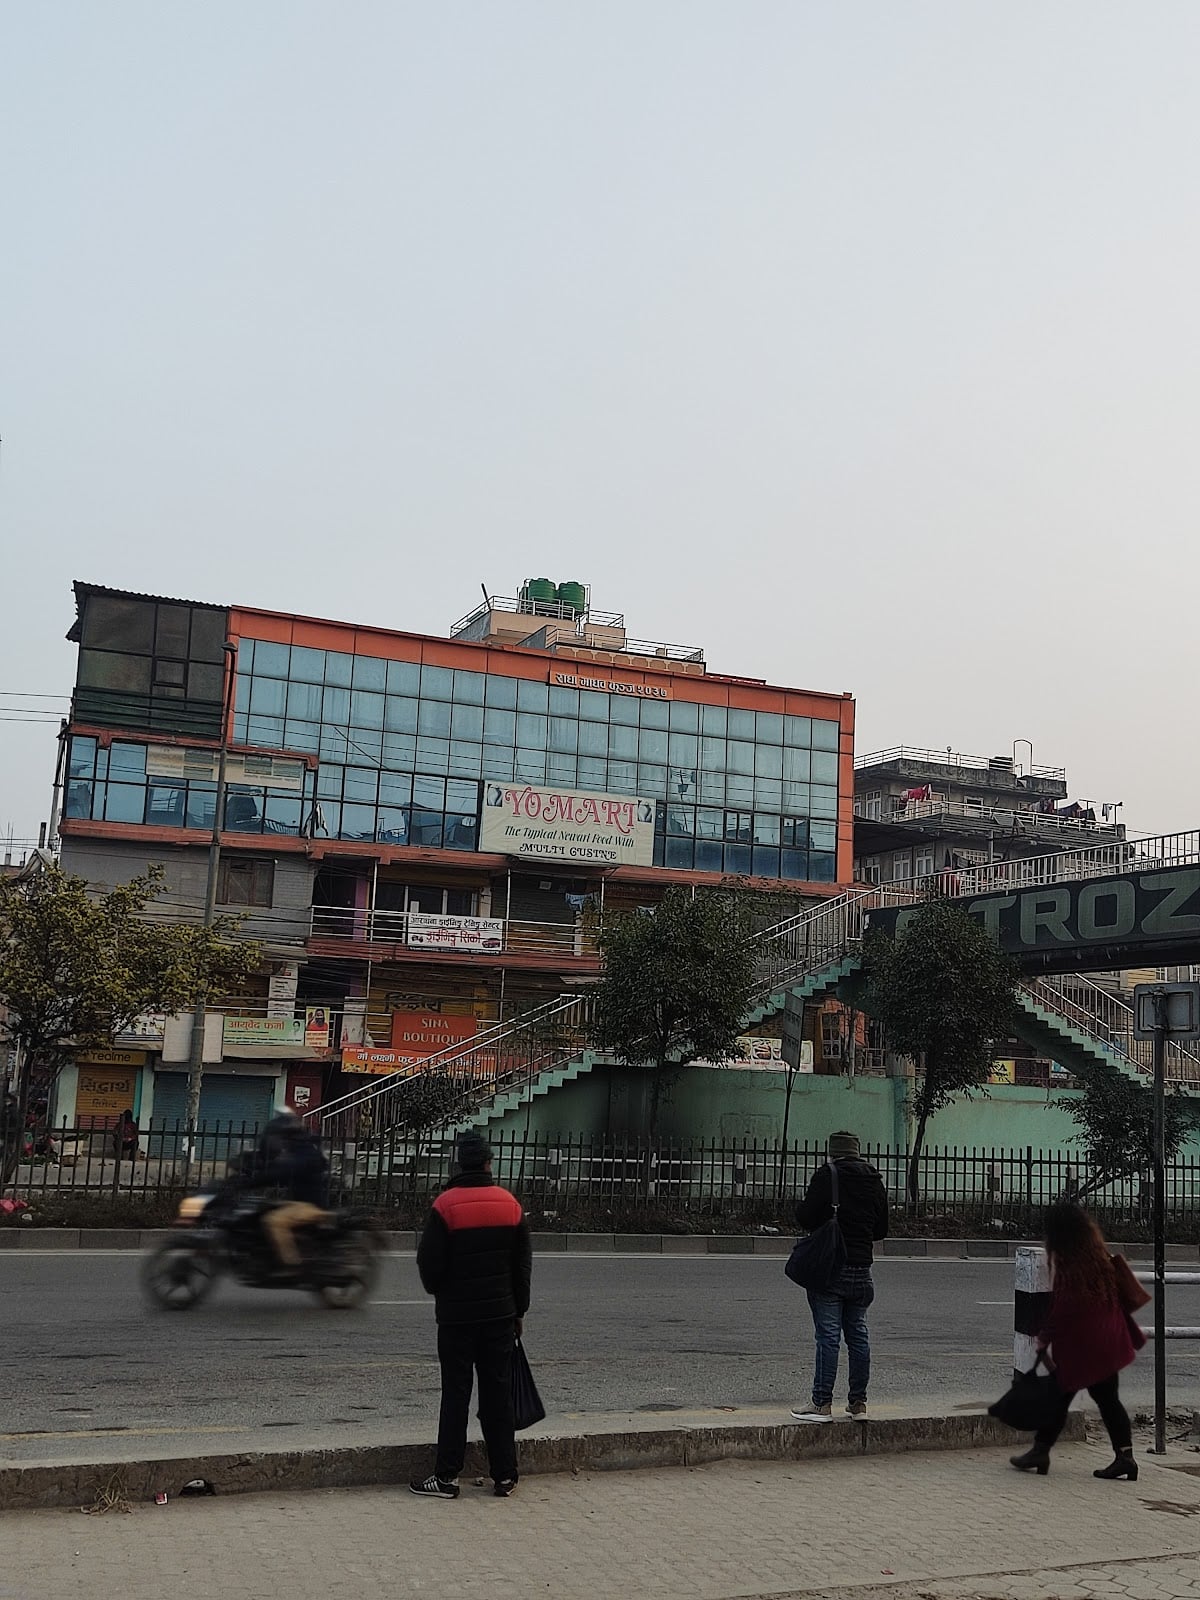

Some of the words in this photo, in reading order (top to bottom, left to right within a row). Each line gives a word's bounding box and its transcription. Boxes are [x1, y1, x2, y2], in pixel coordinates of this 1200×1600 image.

[505, 786, 635, 834] YOMARI
[504, 825, 521, 837] The
[523, 827, 558, 840] Typical
[559, 830, 591, 843] Newari
[592, 833, 613, 845] Food
[615, 836, 634, 848] With
[519, 843, 565, 855] MULTI
[421, 1017, 449, 1029] SINA
[91, 1051, 131, 1062] realme
